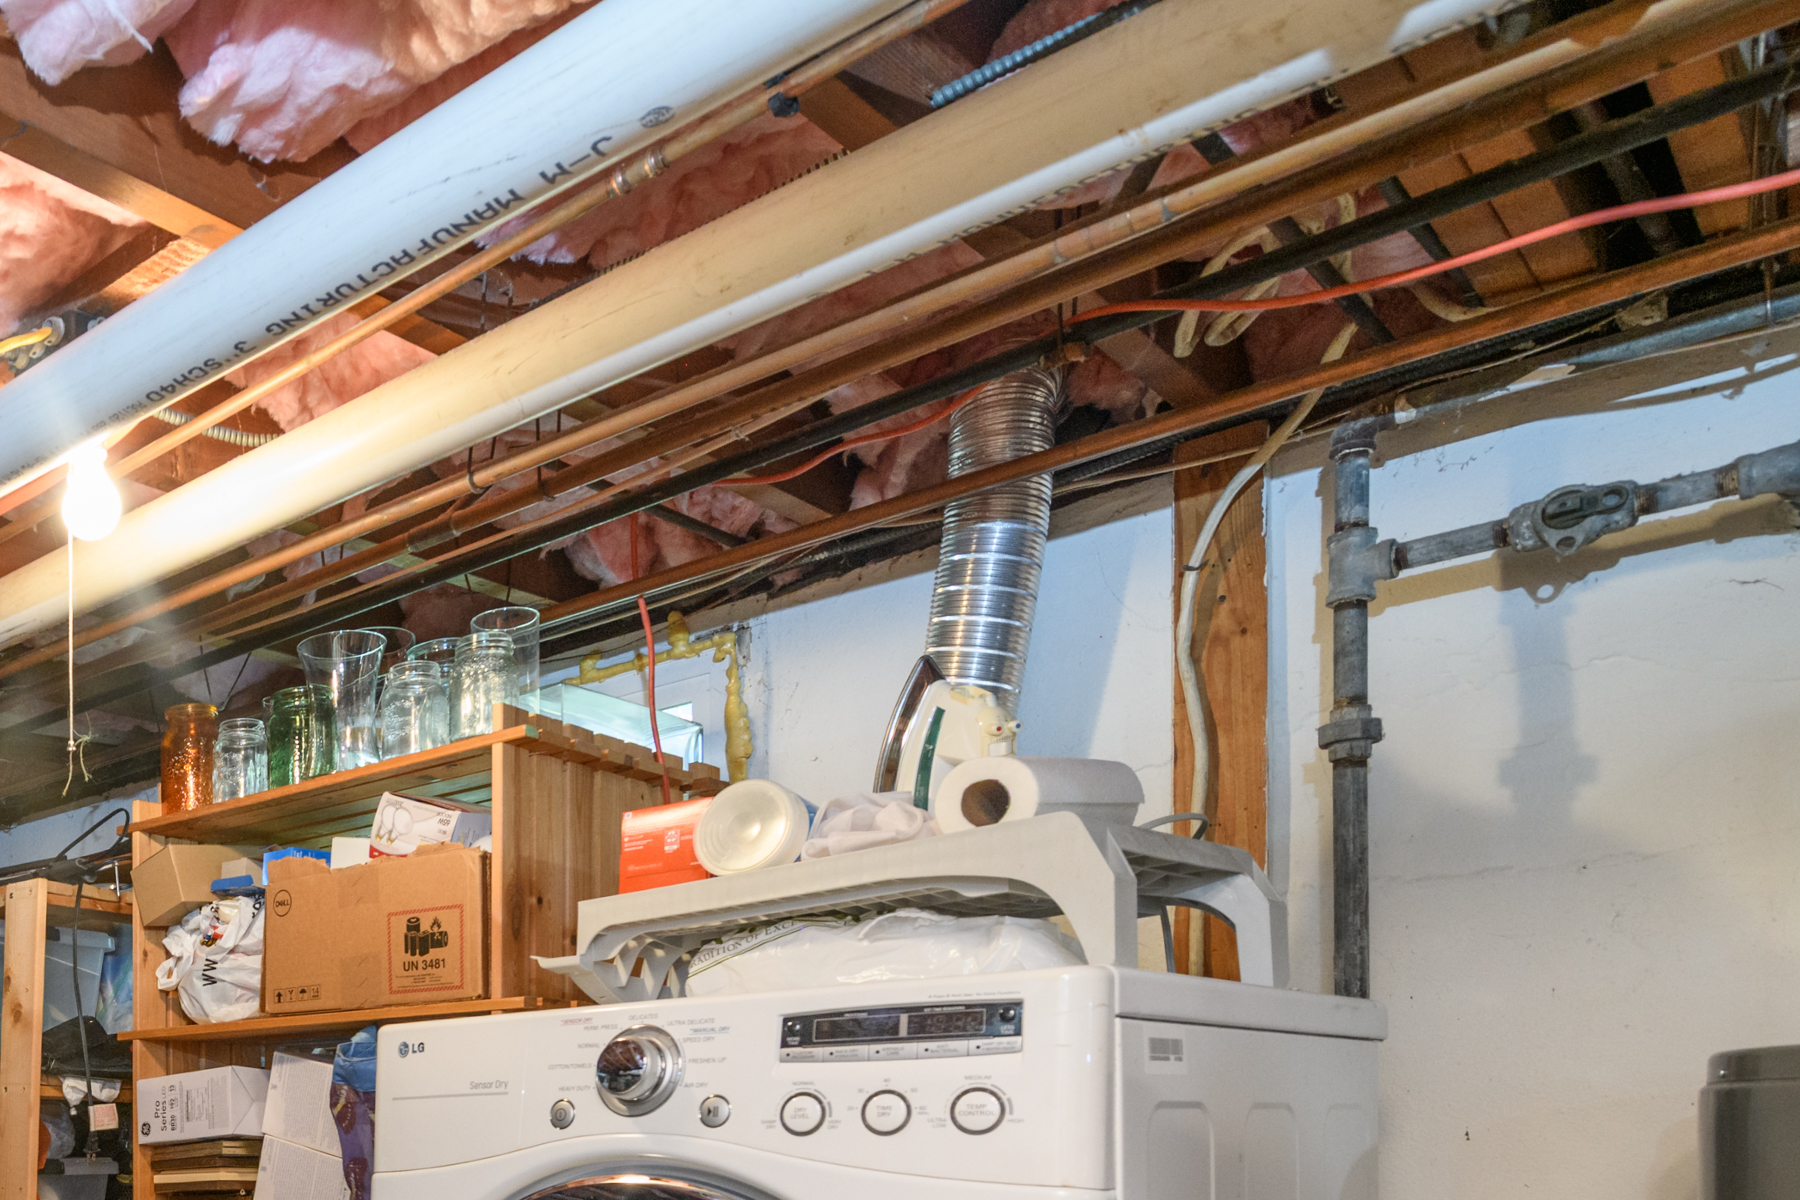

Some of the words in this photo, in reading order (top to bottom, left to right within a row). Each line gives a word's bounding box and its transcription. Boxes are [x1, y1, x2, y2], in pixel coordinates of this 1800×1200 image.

[540, 136, 613, 186] J-M
[266, 189, 524, 338] MANUFACTURING
[437, 818, 451, 827] 65W
[275, 900, 289, 908] DELL
[691, 941, 742, 968] RADITION
[746, 932, 760, 944] OF
[403, 960, 419, 972] UN
[421, 958, 446, 971] 3481
[628, 1013, 659, 1021] DELICATES
[411, 1042, 425, 1054] LG
[470, 1080, 494, 1090] Sensor
[495, 1079, 509, 1091] Dry
[160, 1100, 168, 1132] Series
